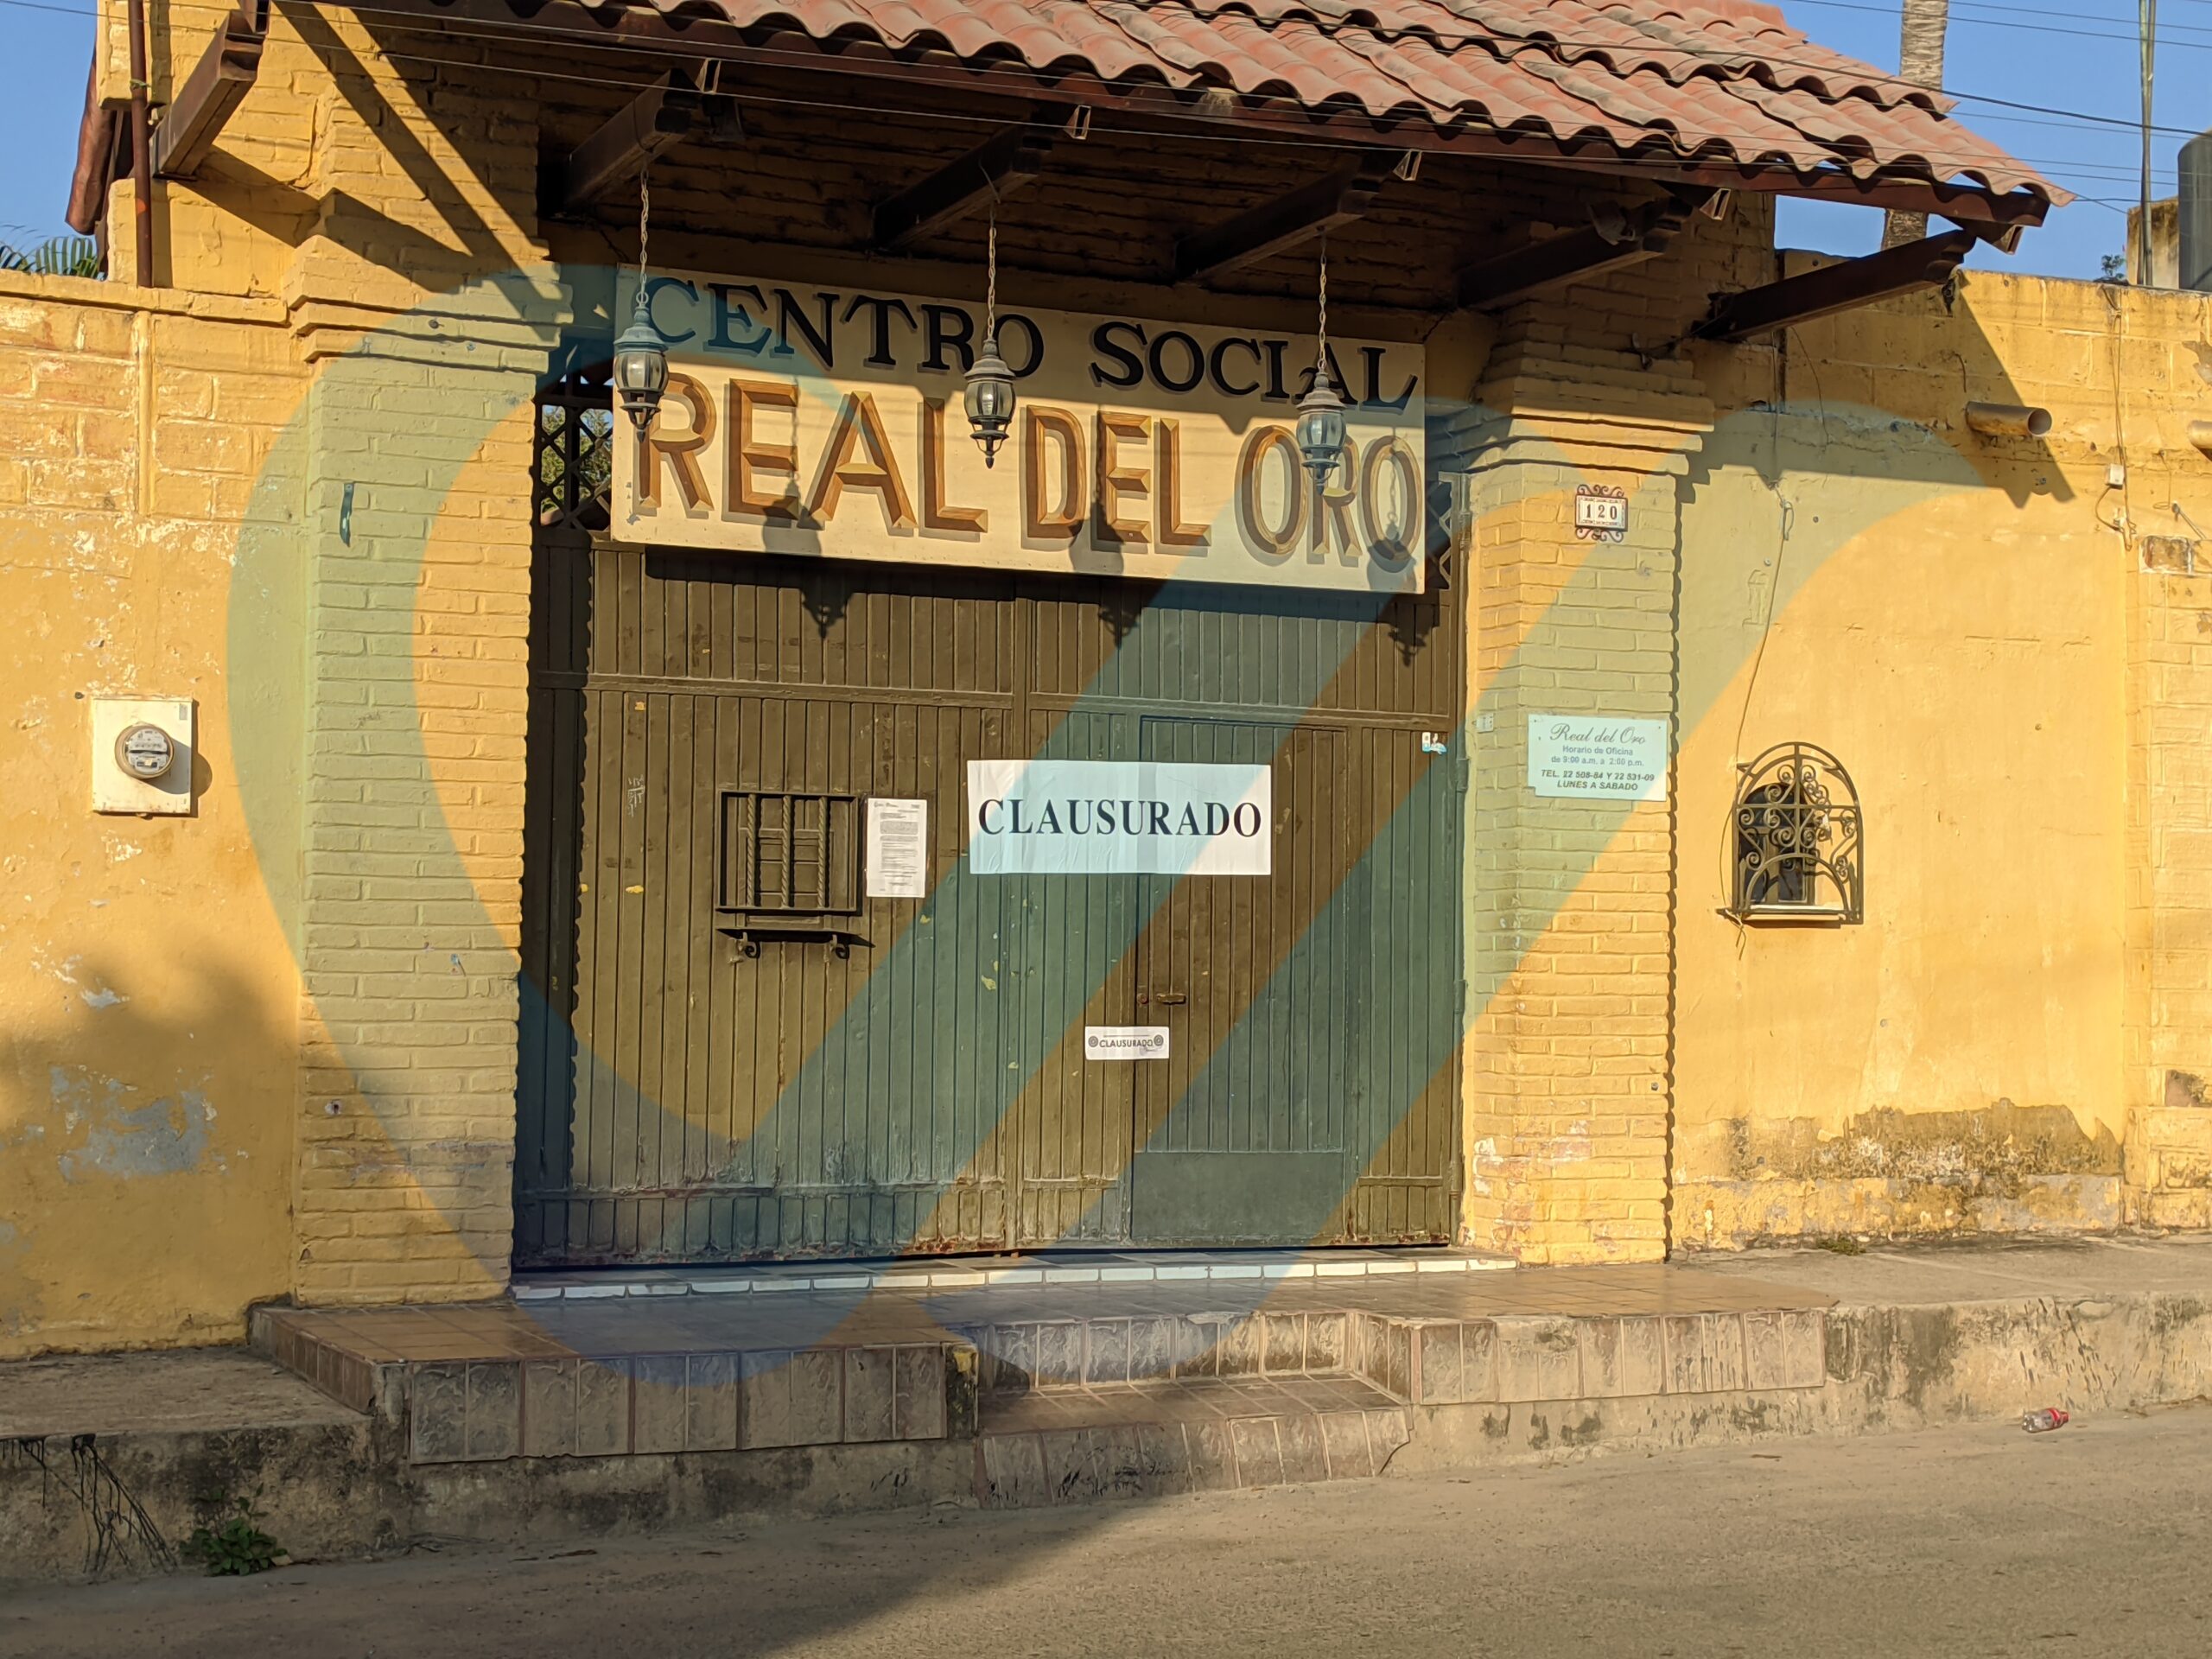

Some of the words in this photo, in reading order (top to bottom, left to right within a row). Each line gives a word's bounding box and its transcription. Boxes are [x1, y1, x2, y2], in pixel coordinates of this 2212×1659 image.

[635, 277, 1045, 378] CENTRO
[1090, 321, 1418, 410] SOCIAL
[635, 372, 988, 534] REAL
[1026, 404, 1211, 548] DEL
[1240, 424, 1422, 561] ORO
[1586, 504, 1618, 520] 120
[1549, 722, 1594, 742] Real
[1594, 727, 1618, 743] del
[1619, 726, 1646, 744] Oro
[1562, 745, 1592, 754] Horario
[1605, 747, 1633, 756] Oficina
[1627, 759, 1644, 767] p.m.
[1541, 769, 1560, 778] TEL.
[1563, 770, 1573, 779] 22
[1606, 772, 1612, 780] Y
[1557, 780, 1588, 789] LUNES
[1599, 782, 1638, 791] SABADO
[978, 798, 1262, 837] CLAUSURADO
[1099, 1039, 1154, 1048] CLAUSURADO
